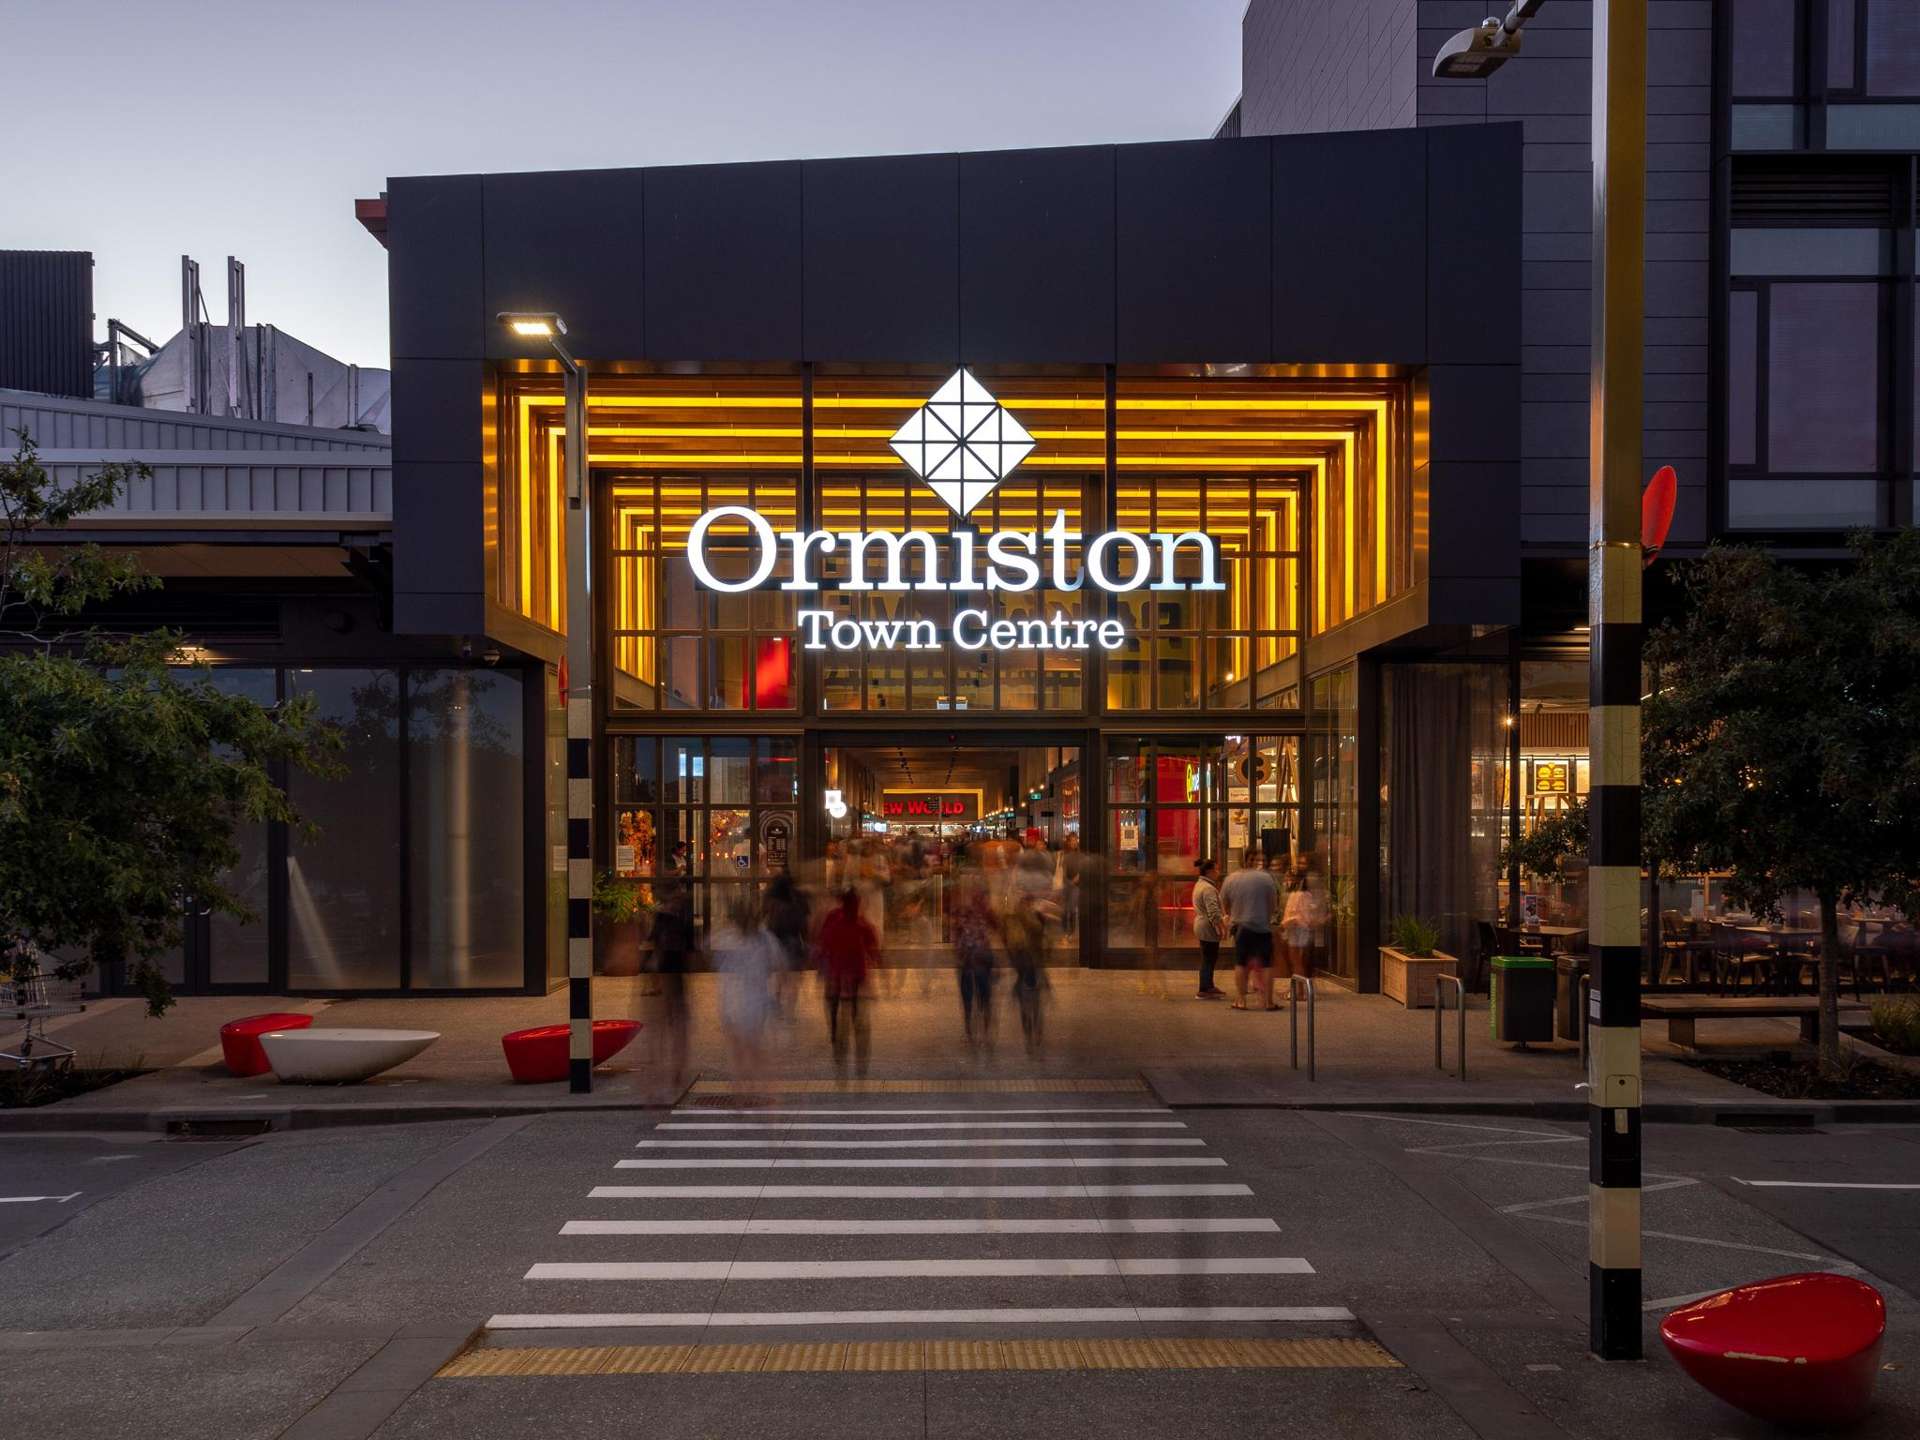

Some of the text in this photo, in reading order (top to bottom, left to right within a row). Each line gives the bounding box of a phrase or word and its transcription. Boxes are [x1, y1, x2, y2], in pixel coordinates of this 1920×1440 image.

[687, 506, 1226, 592] Ormiston
[798, 609, 1125, 650] Town Centre
[907, 799, 966, 816] WOLD
